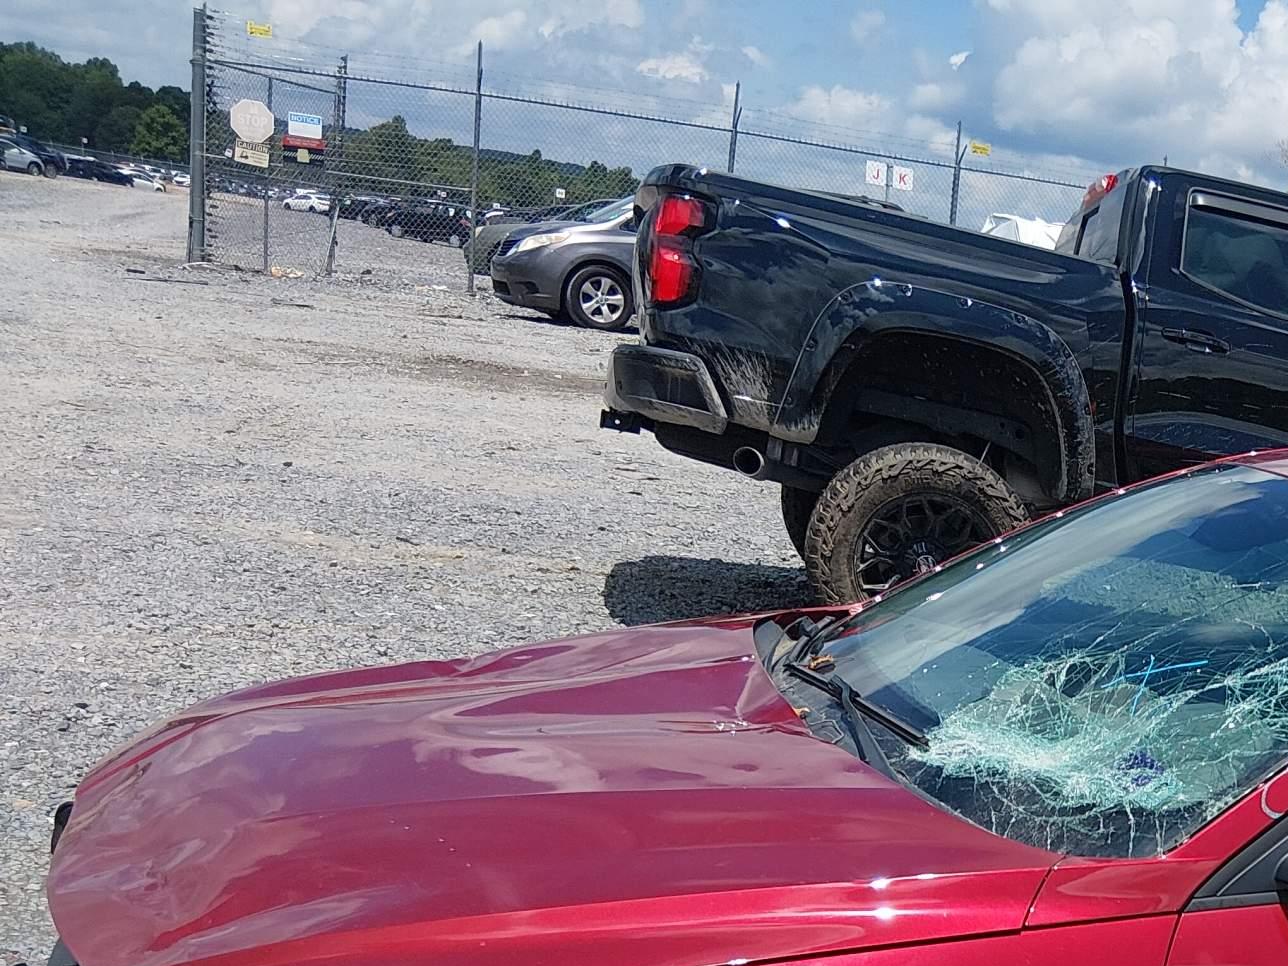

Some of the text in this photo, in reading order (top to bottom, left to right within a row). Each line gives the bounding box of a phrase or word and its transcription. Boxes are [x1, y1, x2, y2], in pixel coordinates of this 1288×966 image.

[239, 113, 268, 128] STOP
[237, 141, 268, 153] CAUTION
[872, 168, 880, 180] J
[899, 173, 907, 186] K
